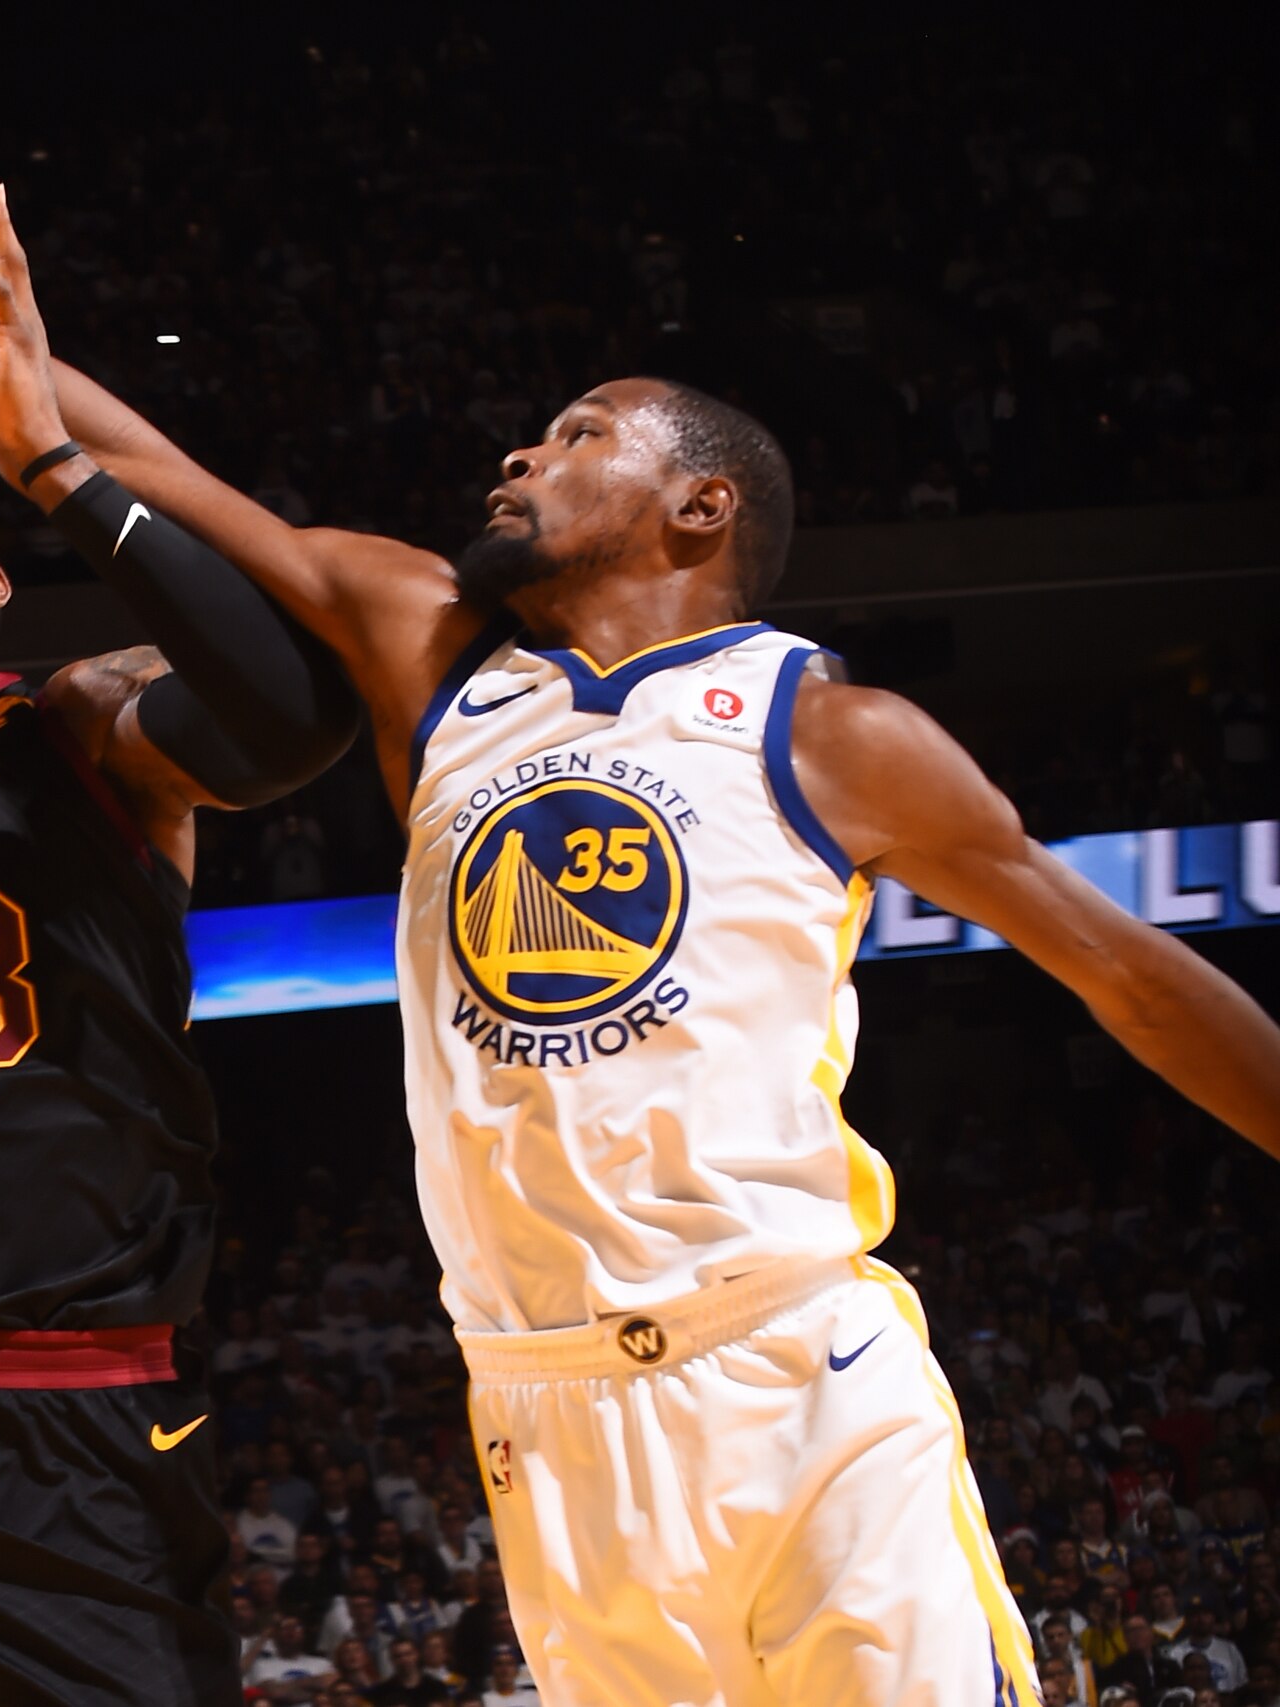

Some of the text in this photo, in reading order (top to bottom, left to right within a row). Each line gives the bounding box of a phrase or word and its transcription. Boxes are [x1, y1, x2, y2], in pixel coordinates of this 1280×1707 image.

[712, 692, 735, 716] R
[453, 752, 702, 833] GOLDEN STATE
[557, 827, 651, 893] 35
[451, 976, 690, 1067] WARRIORS
[622, 1326, 658, 1357] W
